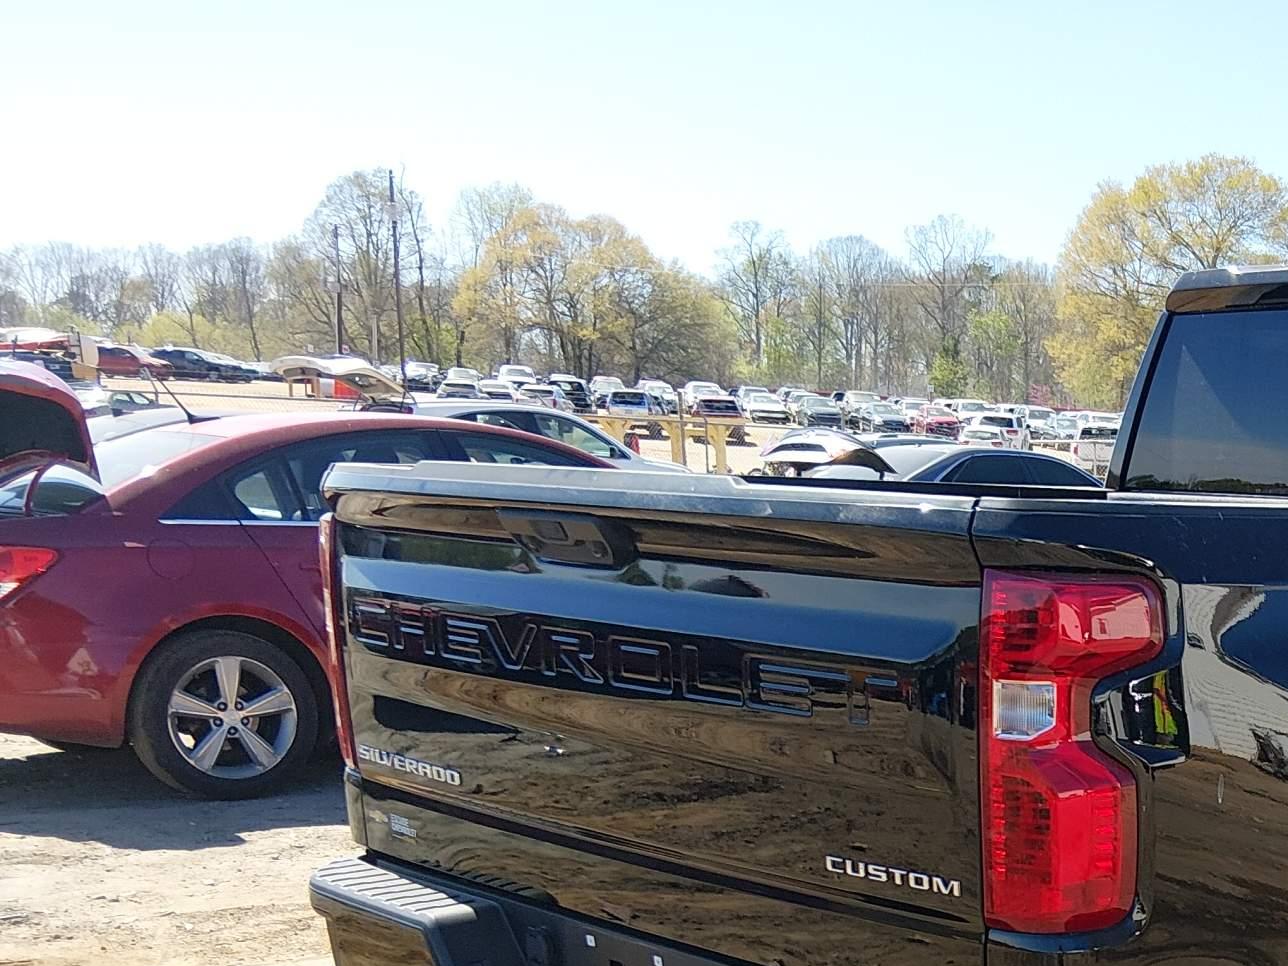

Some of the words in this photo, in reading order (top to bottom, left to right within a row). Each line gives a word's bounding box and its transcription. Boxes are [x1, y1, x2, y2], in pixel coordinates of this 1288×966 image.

[353, 599, 898, 727] CHEVROLET
[359, 744, 462, 786] SILVERADO
[825, 855, 962, 897] CUSTOM
